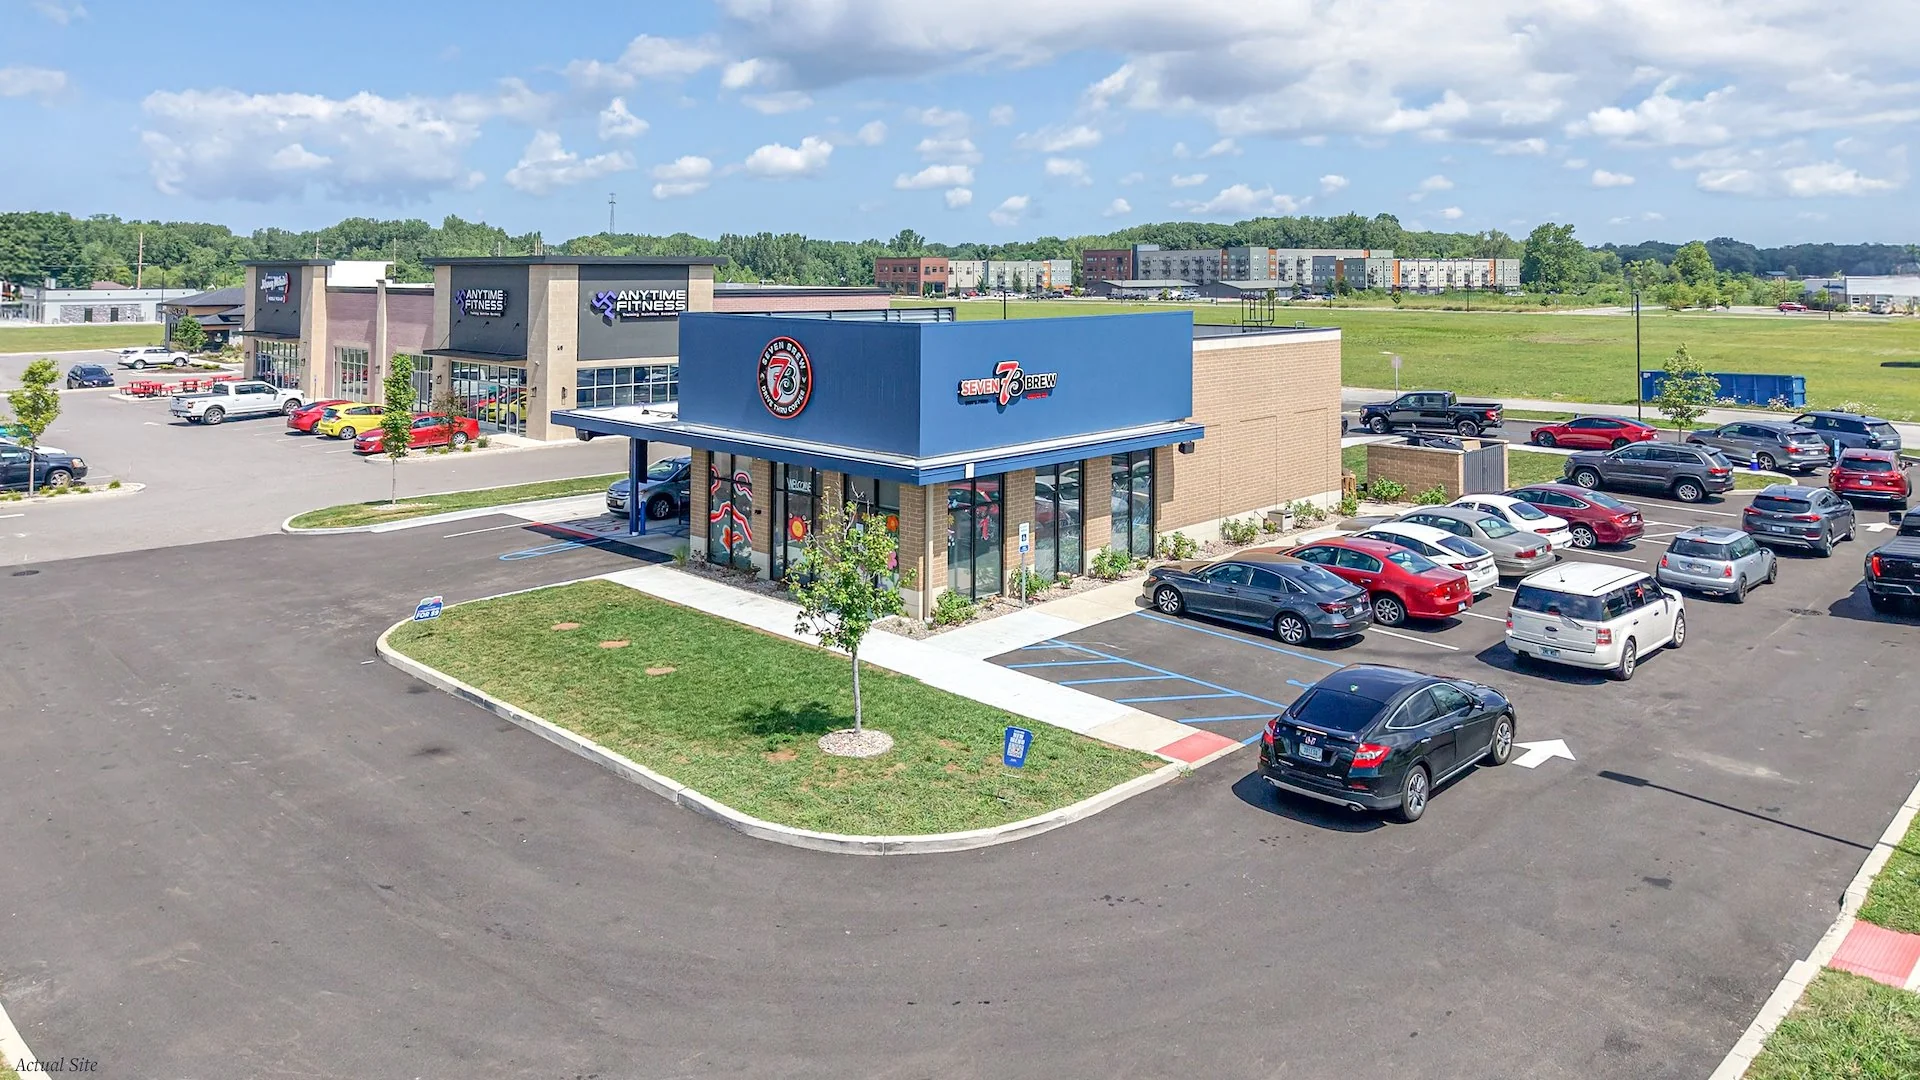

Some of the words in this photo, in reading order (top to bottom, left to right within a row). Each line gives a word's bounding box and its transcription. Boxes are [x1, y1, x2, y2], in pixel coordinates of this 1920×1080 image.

[466, 289, 504, 300] ANYTIME
[617, 290, 686, 300] ANYTIME
[465, 300, 503, 310] FITNESS
[616, 301, 686, 311] FITNESS
[762, 341, 785, 366] SEVEN
[786, 342, 806, 369] BREW
[960, 378, 1000, 396] SEVEN
[1024, 372, 1058, 390] BREW
[761, 385, 774, 408] DRIVE
[773, 403, 788, 414] THRU
[788, 389, 806, 413] COFFEE
[786, 477, 812, 493] WELCOME
[416, 611, 430, 619] FOR
